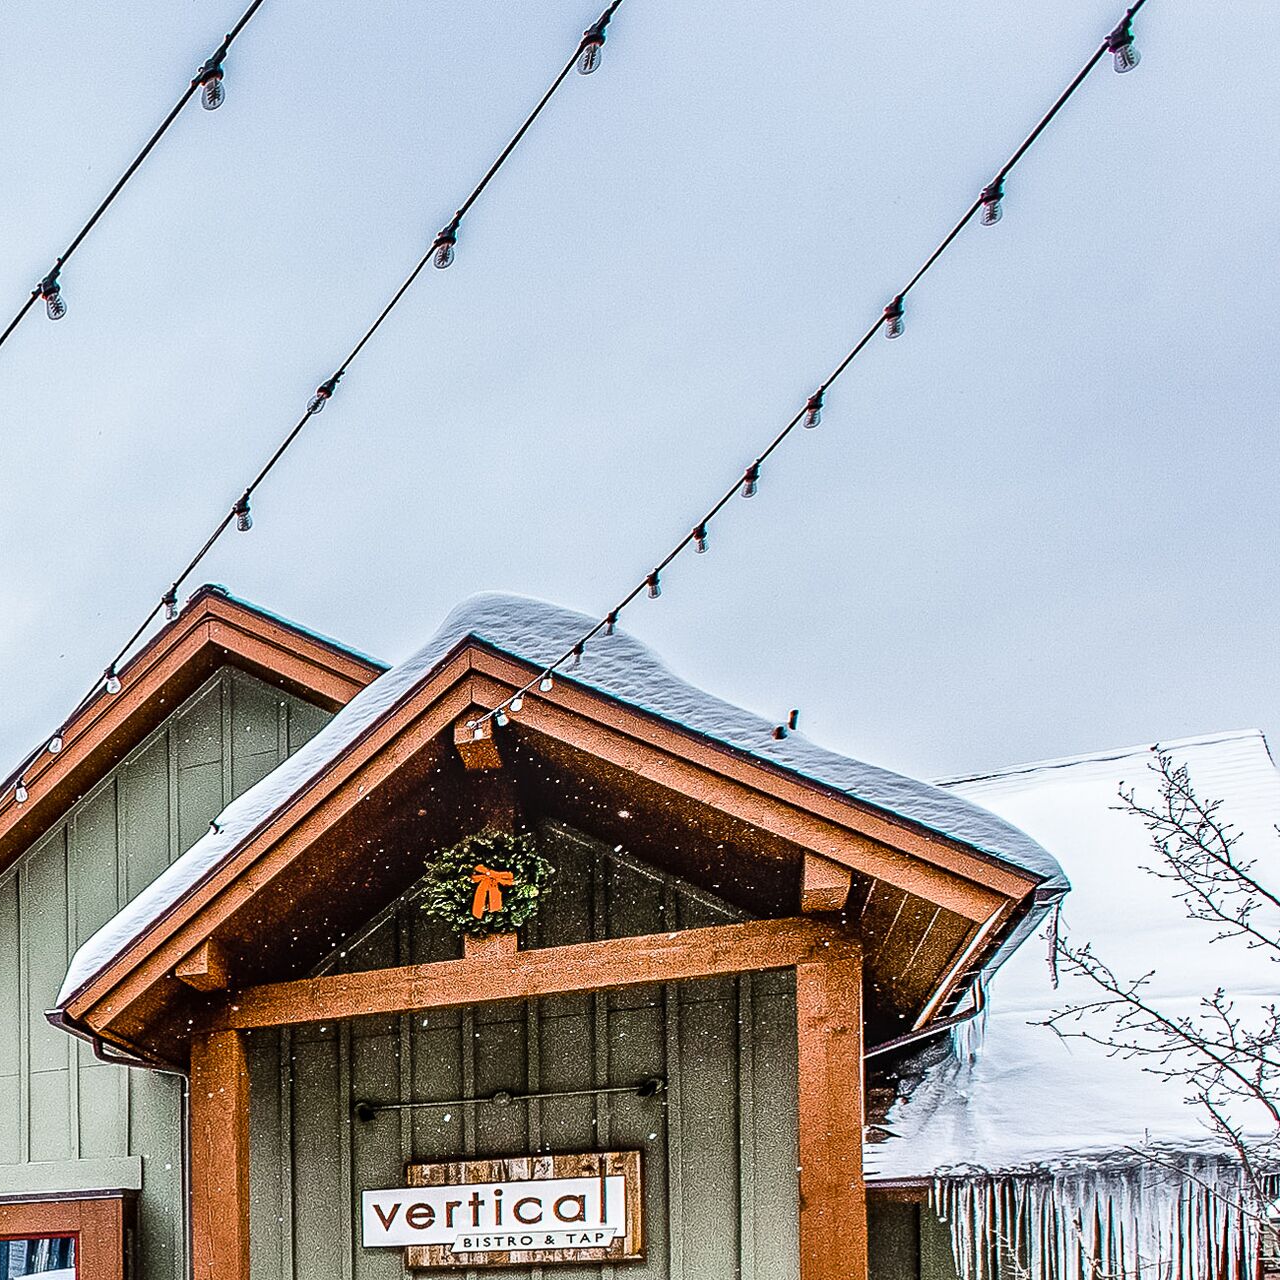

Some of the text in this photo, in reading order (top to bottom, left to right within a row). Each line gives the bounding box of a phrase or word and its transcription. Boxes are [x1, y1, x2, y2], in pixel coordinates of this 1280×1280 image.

[372, 1157, 607, 1232] vertical
[462, 1232, 605, 1248] BISTRO & TAP
